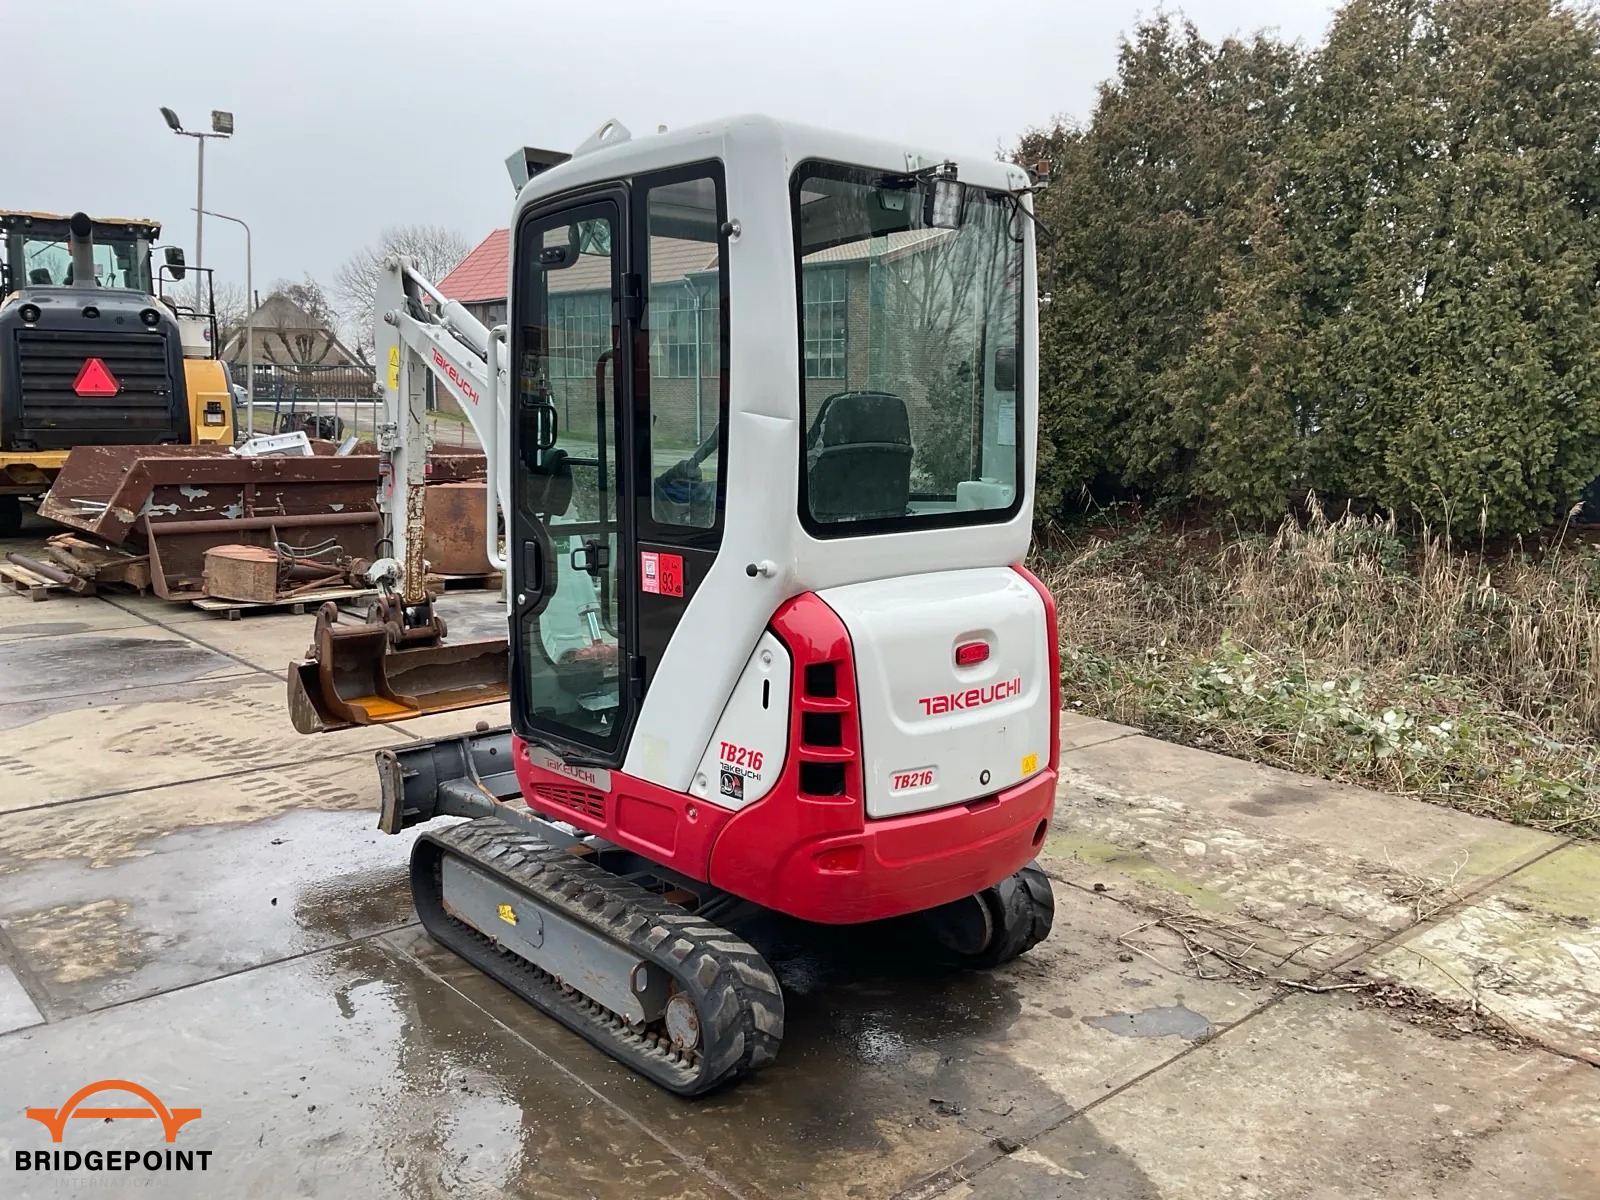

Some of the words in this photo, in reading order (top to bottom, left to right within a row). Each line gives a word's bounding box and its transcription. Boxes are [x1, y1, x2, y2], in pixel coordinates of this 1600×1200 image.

[432, 347, 479, 405] TAKEUCHI
[662, 571, 674, 592] 93
[918, 678, 1021, 715] TAKEUCHI
[544, 756, 595, 784] TAKEUCHI
[720, 741, 764, 771] TB216
[720, 761, 762, 781] TAKEUCHI
[894, 771, 933, 790] TB216
